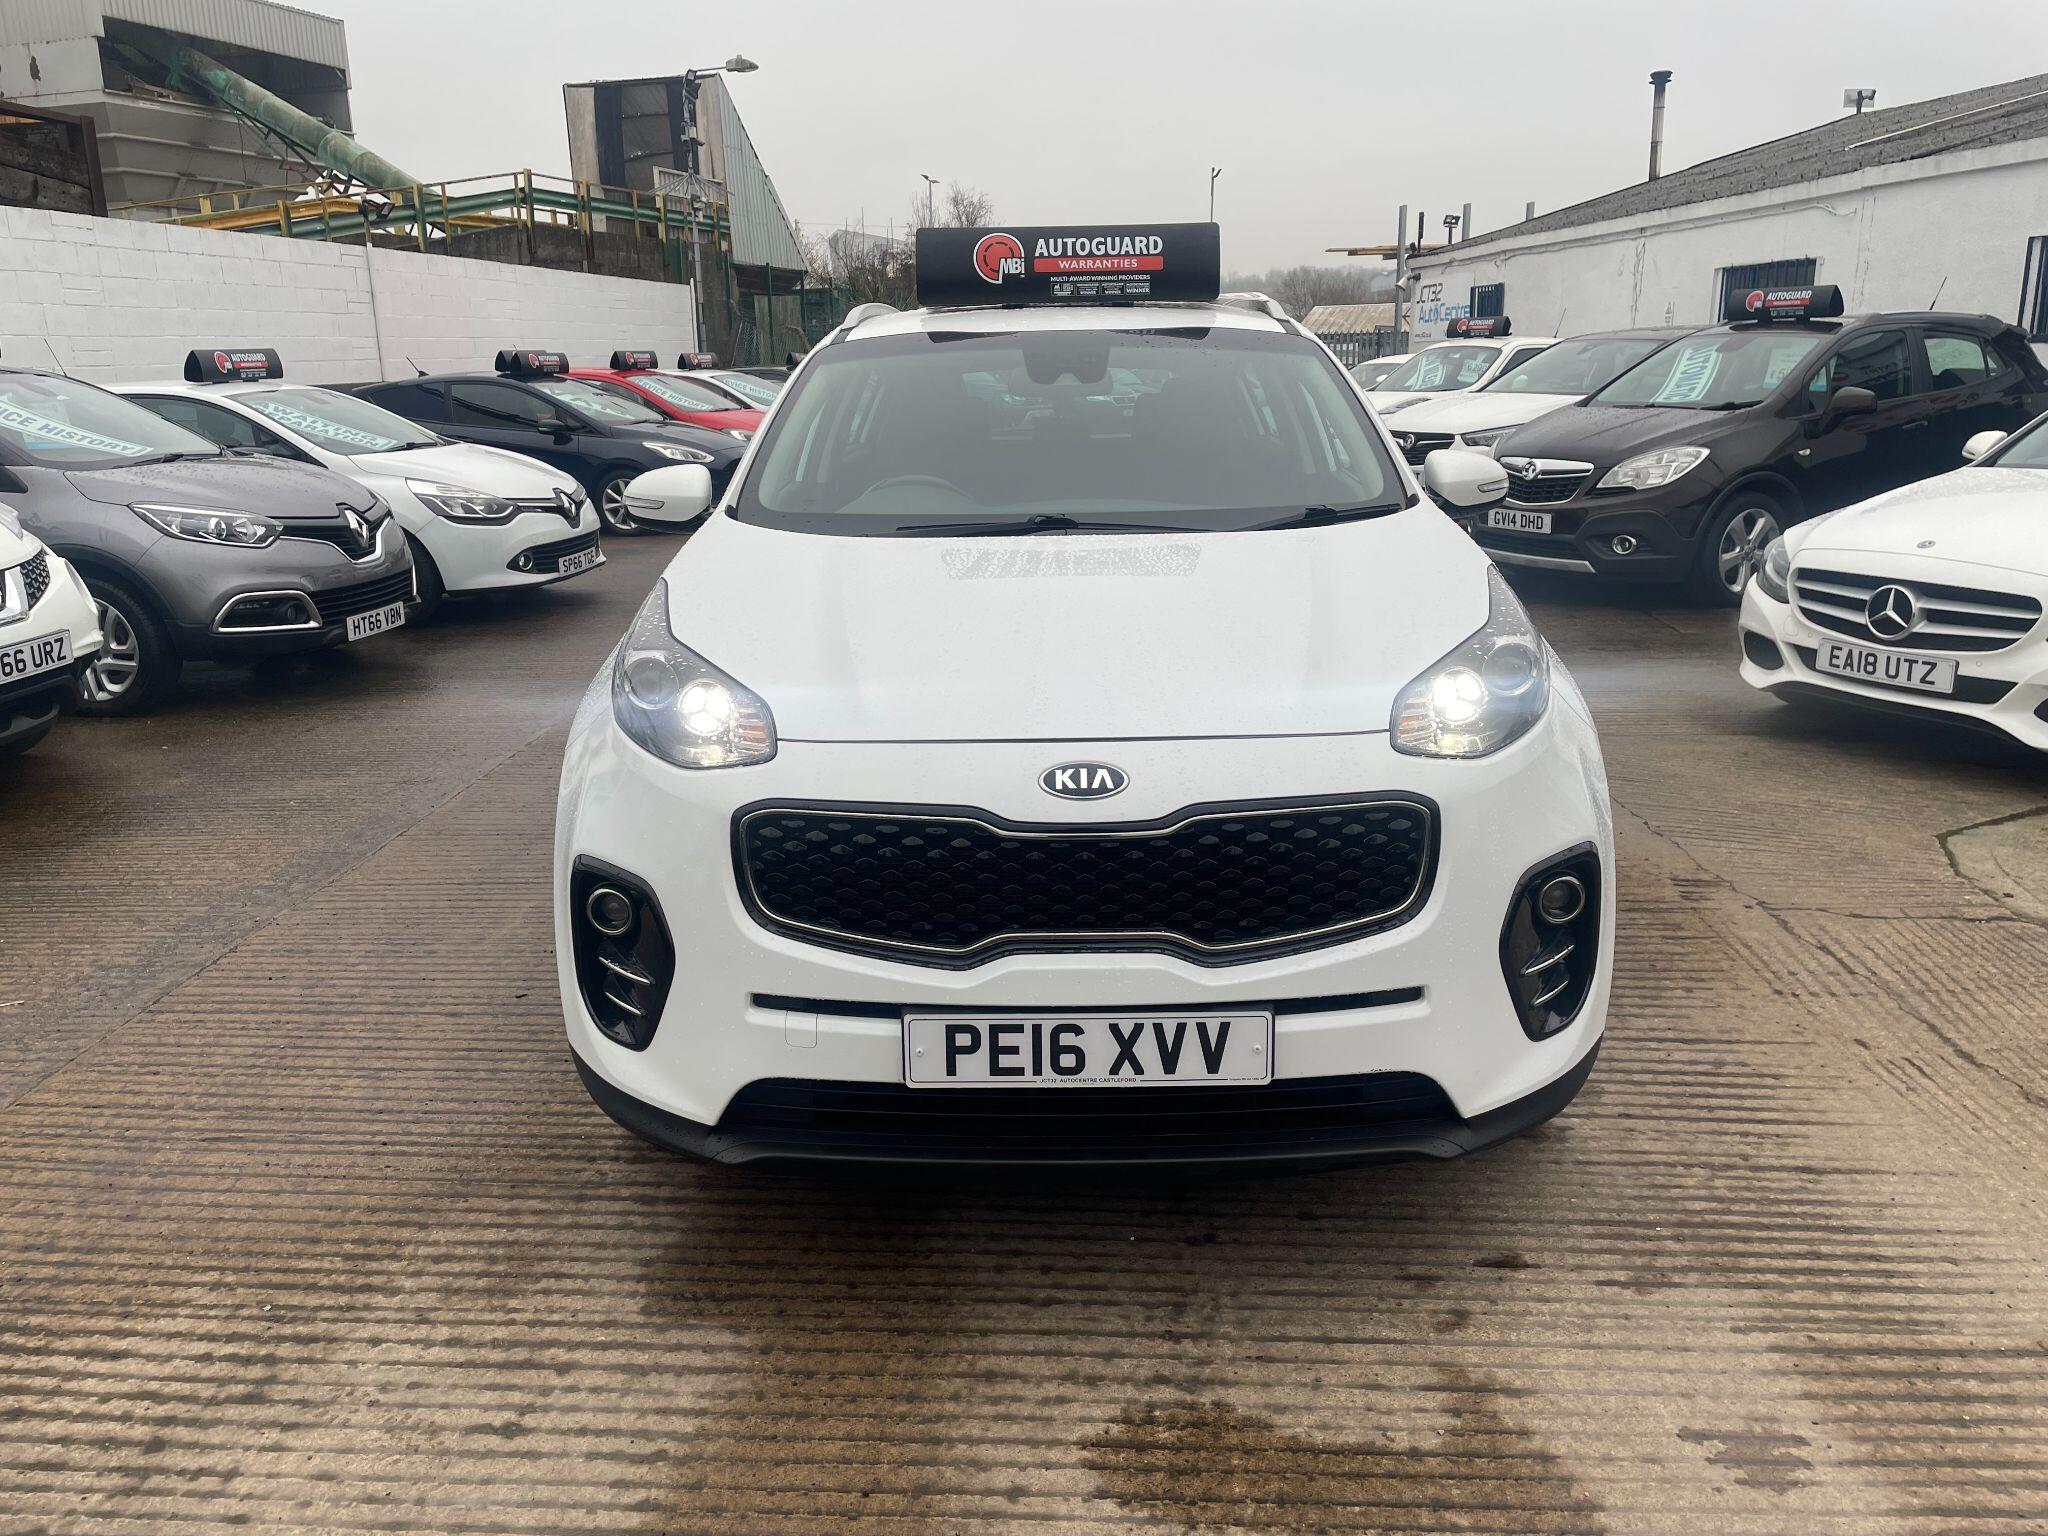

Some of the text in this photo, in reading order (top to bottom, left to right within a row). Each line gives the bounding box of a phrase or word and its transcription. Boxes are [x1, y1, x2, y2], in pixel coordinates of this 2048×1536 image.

[1034, 235, 1163, 257] AUTOGUARD
[1058, 258, 1138, 269] WARRANTIES
[1766, 290, 1812, 301] AUTOGUARD
[38, 422, 137, 452] HISTORY
[1493, 511, 1544, 530] GV14 DHD
[562, 555, 583, 573] SP66
[352, 604, 402, 637] HT66 VBN
[0, 636, 67, 678] 66 URZ
[1828, 644, 1938, 686] EA18 UTZ
[1054, 768, 1115, 790] KIA
[944, 1021, 1232, 1077] PE16 XVV
